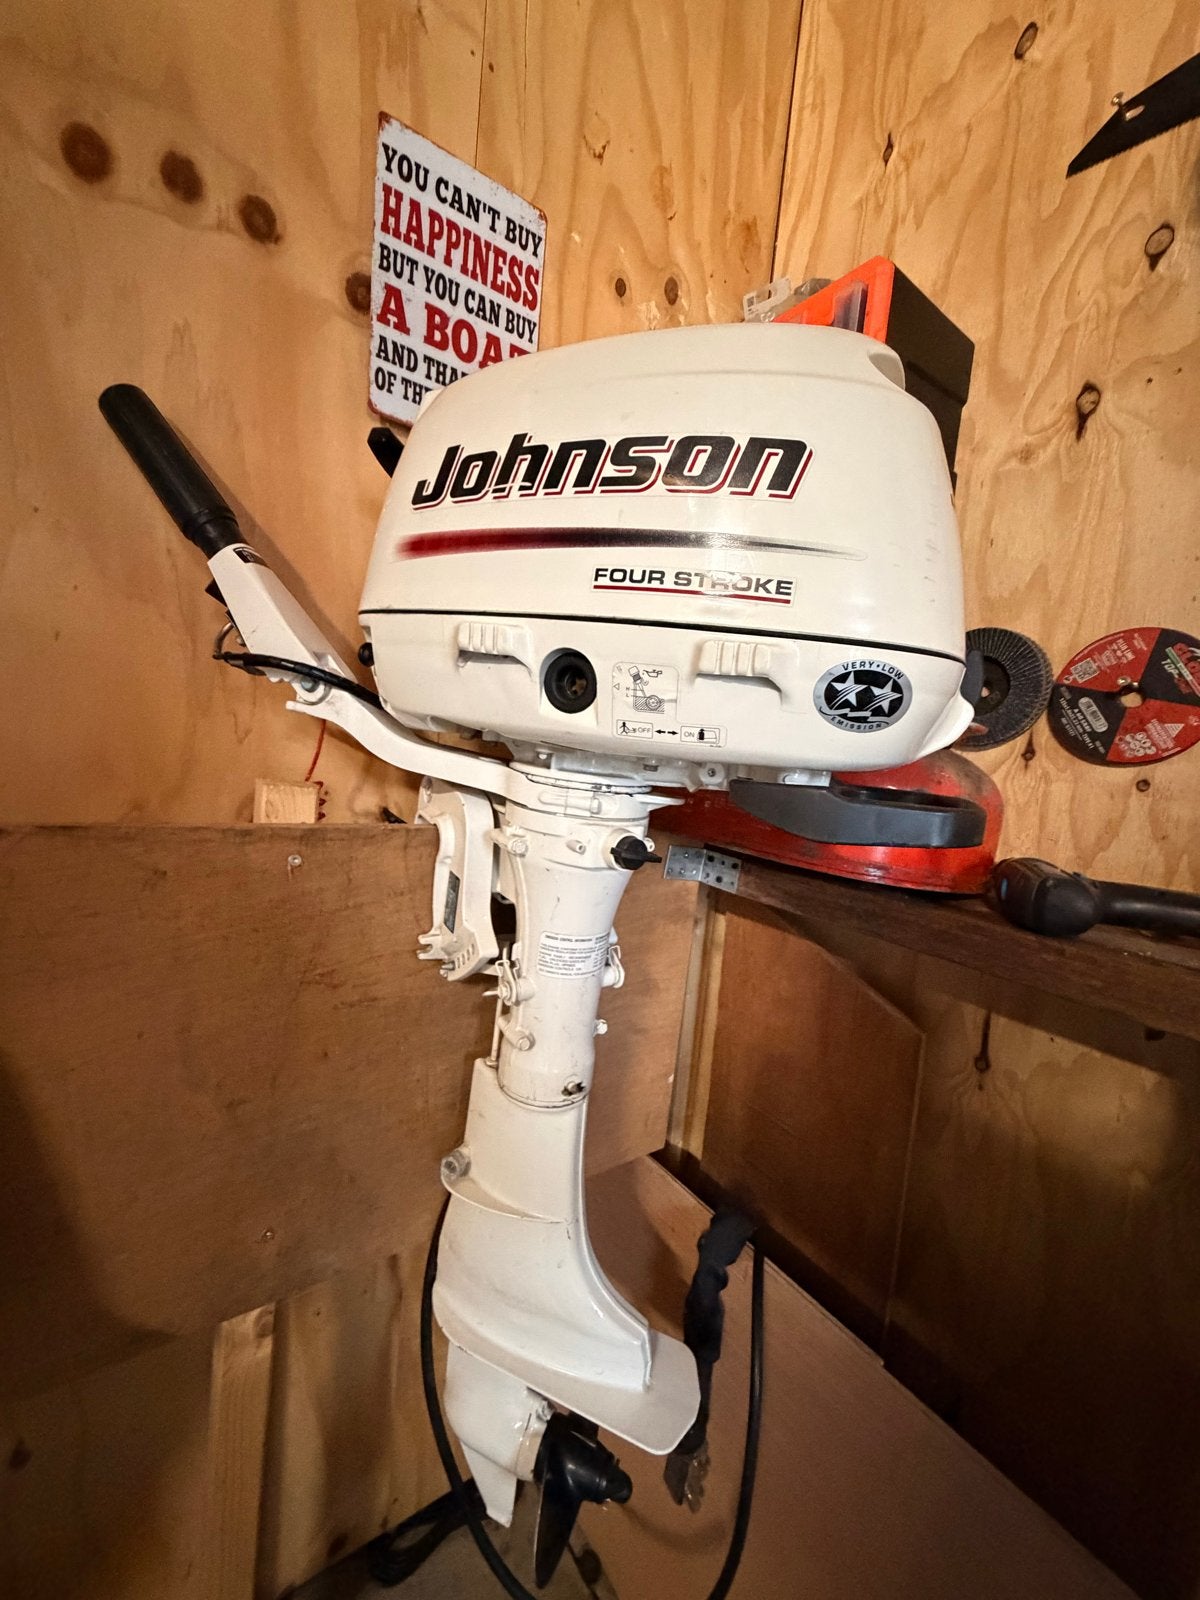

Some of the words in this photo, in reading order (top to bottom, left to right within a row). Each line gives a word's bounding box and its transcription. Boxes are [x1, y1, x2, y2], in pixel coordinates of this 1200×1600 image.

[382, 142, 430, 192] YOU
[435, 176, 500, 233] CAN'T
[505, 216, 543, 258] BUY
[380, 183, 539, 312] HAPPINESS
[376, 283, 410, 336] A
[378, 242, 418, 285] BUT
[423, 264, 461, 307] YOU
[464, 288, 500, 327] CAN
[505, 312, 537, 344] BUY
[375, 334, 419, 373] AND
[423, 354, 469, 386] THA
[374, 367, 397, 395] OF
[401, 376, 432, 406] TH
[411, 432, 814, 511] Johnson
[593, 567, 666, 585] FOUR
[673, 571, 794, 597] STROKE
[842, 660, 875, 671] VERY
[881, 663, 904, 680] LOW
[830, 716, 882, 731] EMISSION
